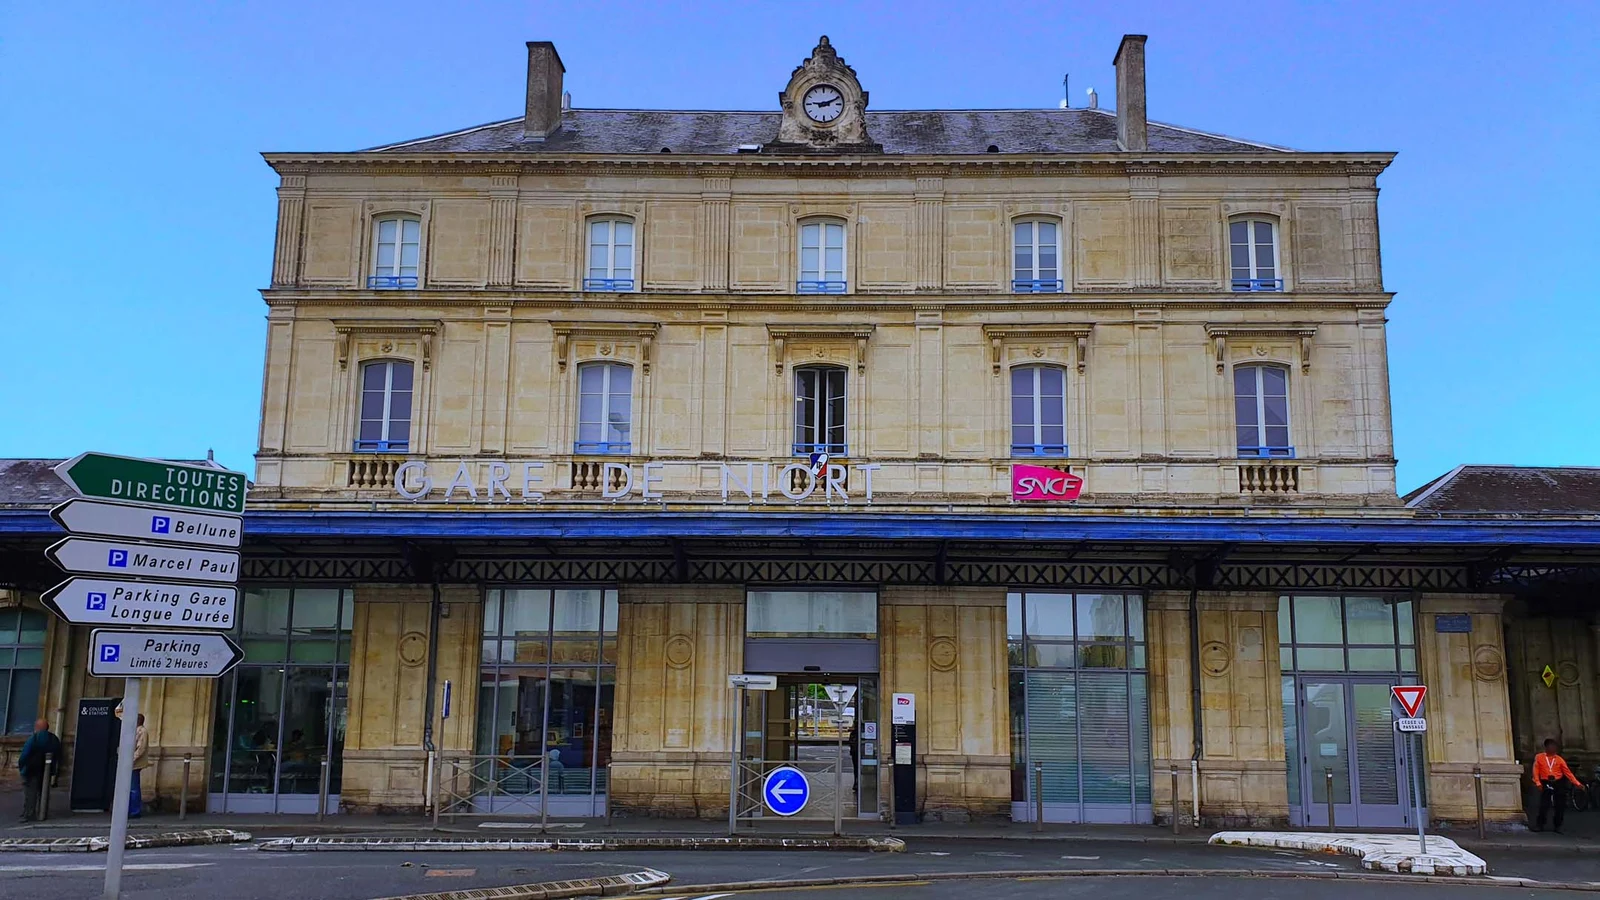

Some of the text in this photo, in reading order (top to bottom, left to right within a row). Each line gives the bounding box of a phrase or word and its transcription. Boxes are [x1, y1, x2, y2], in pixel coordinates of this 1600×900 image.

[166, 467, 239, 492] TOUTES
[395, 460, 881, 500] GARE DE NIORT
[1015, 477, 1080, 495] SNCF
[111, 479, 237, 509] DIRECTIONS
[175, 520, 237, 538] Bellune
[133, 554, 192, 570] Marcel
[200, 559, 236, 574] Paul
[112, 587, 180, 607] Parking
[189, 592, 227, 606] Gare
[111, 605, 230, 623] Longue Durée
[144, 639, 201, 656] Parking
[130, 657, 162, 669] Limité
[174, 658, 208, 669] Heures
